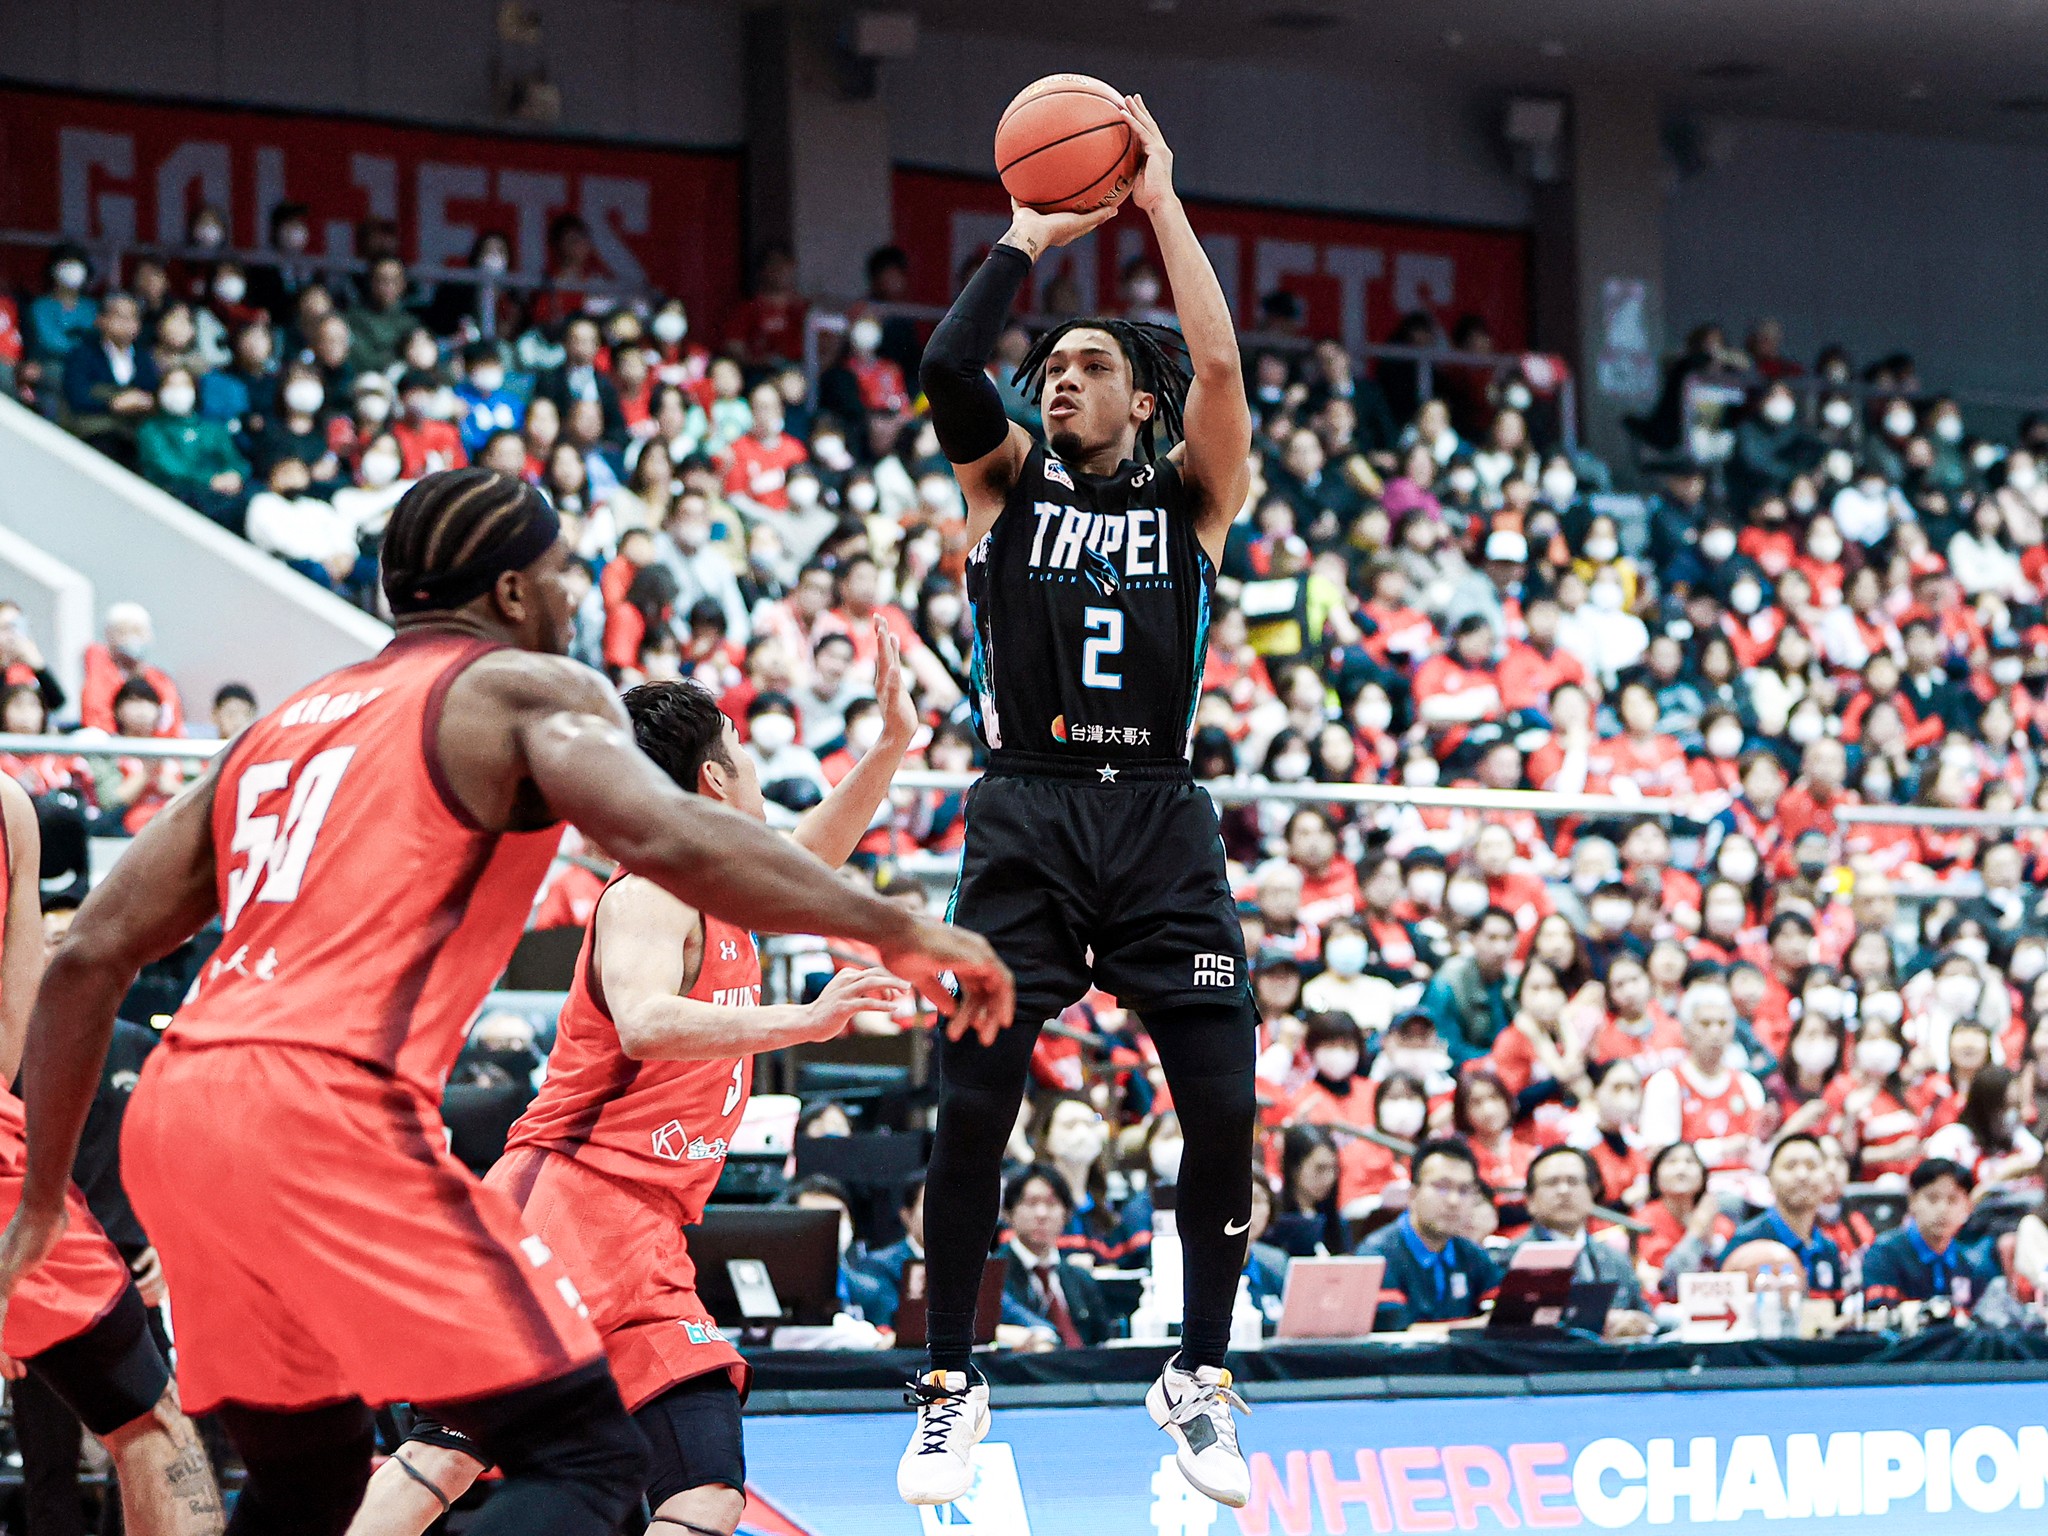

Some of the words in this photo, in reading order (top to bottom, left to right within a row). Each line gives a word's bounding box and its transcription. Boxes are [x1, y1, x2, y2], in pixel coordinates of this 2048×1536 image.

[1028, 501, 1169, 576] TAIPEI
[1082, 606, 1124, 690] 2
[1070, 723, 1152, 746] 台灣大哥大
[223, 745, 359, 932] 50
